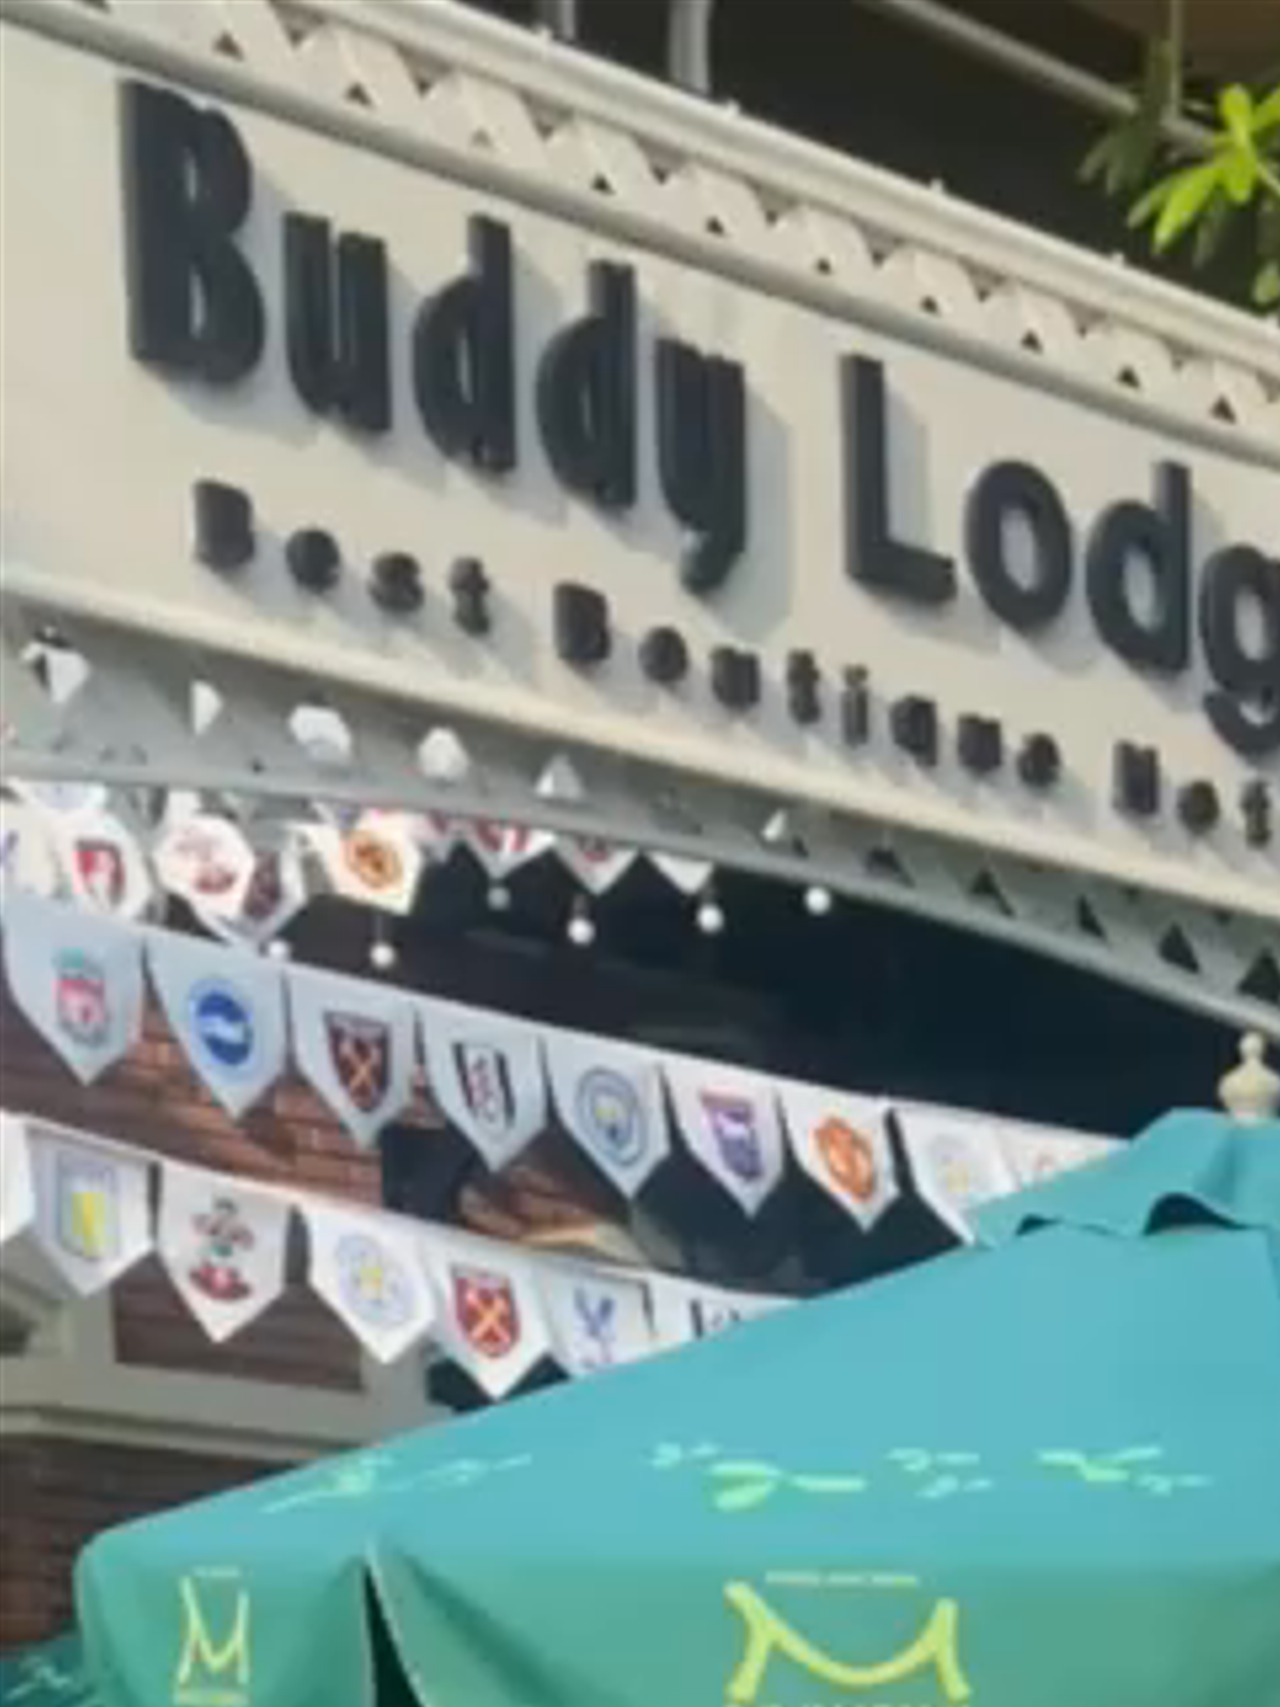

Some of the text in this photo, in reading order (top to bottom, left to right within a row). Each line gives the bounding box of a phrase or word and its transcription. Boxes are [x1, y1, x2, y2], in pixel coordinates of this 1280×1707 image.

[123, 69, 748, 600] Buddy
[192, 478, 493, 638] Best
[553, 580, 1062, 792] Boutique
